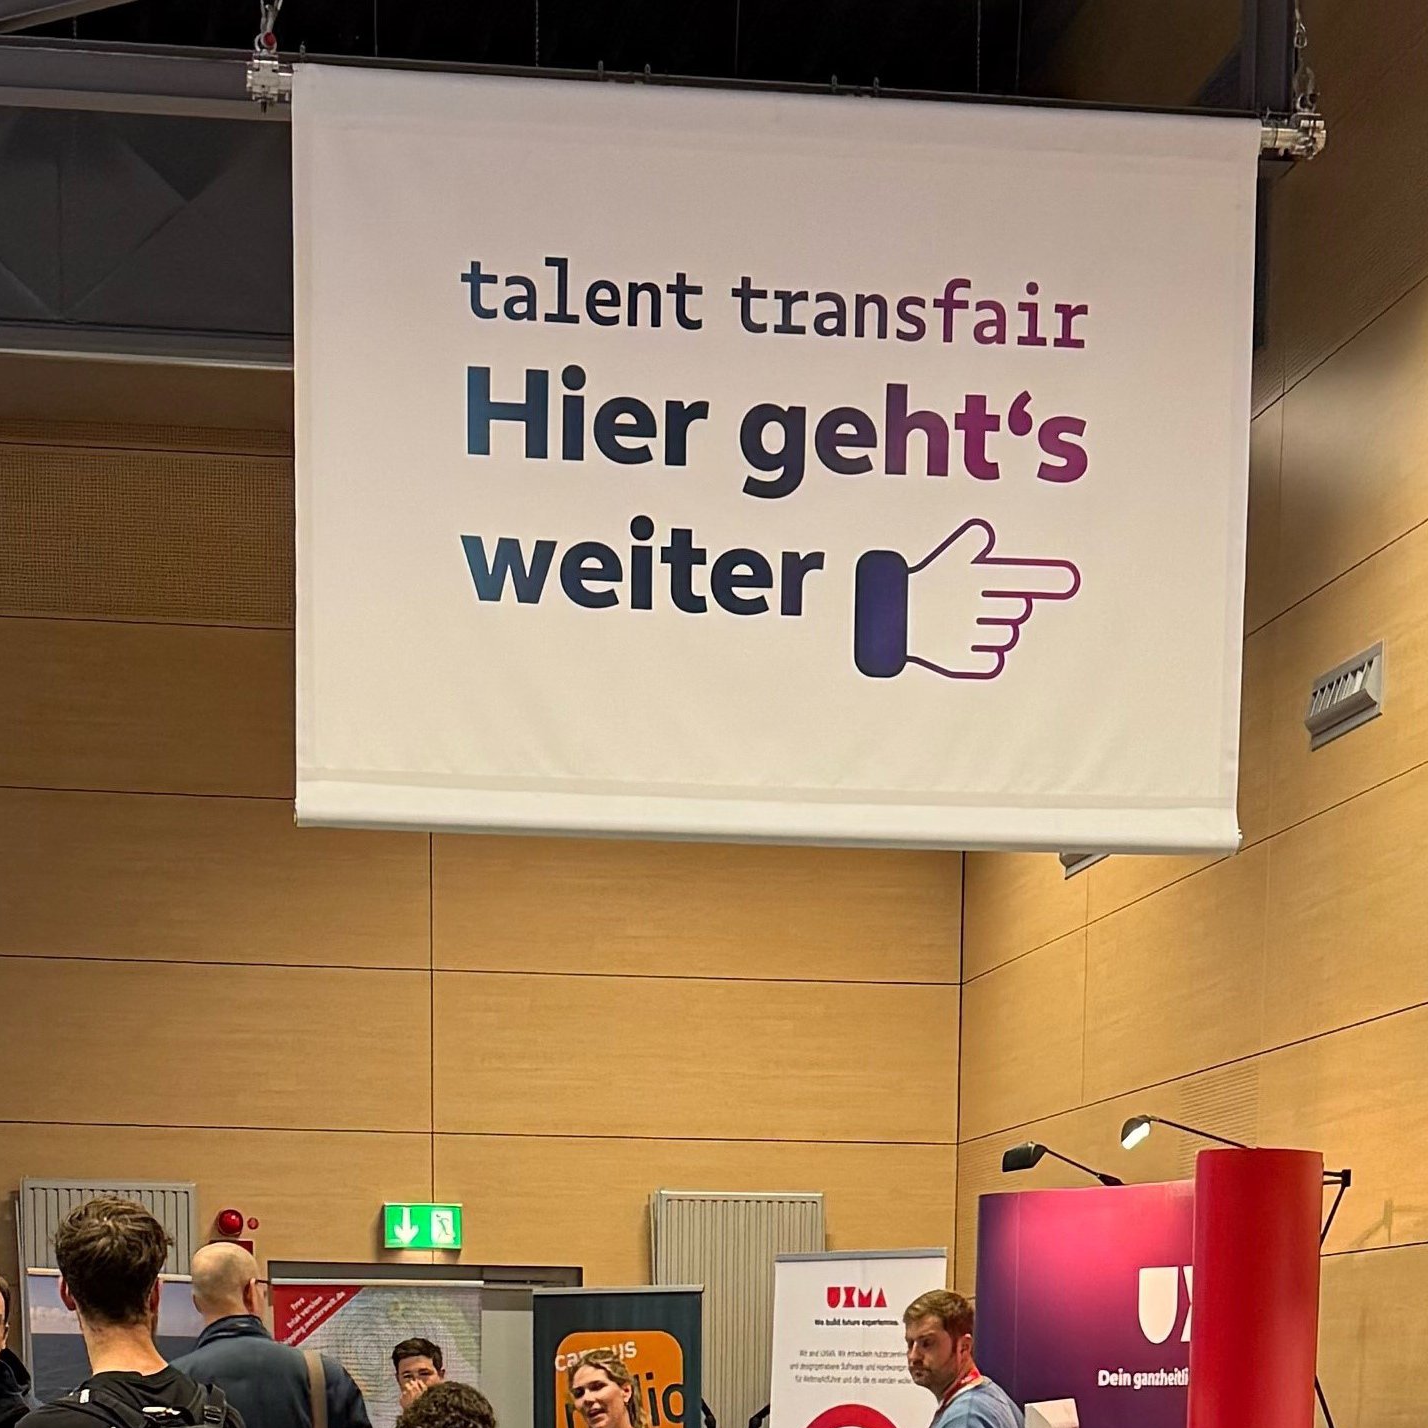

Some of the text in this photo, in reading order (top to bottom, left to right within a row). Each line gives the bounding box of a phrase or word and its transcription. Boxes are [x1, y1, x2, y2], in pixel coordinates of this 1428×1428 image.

[461, 257, 1088, 348] talent transfair
[468, 365, 709, 466] Hier
[461, 515, 825, 616] weiter
[827, 1287, 887, 1308] UXMA
[1098, 1369, 1131, 1387] Dein
